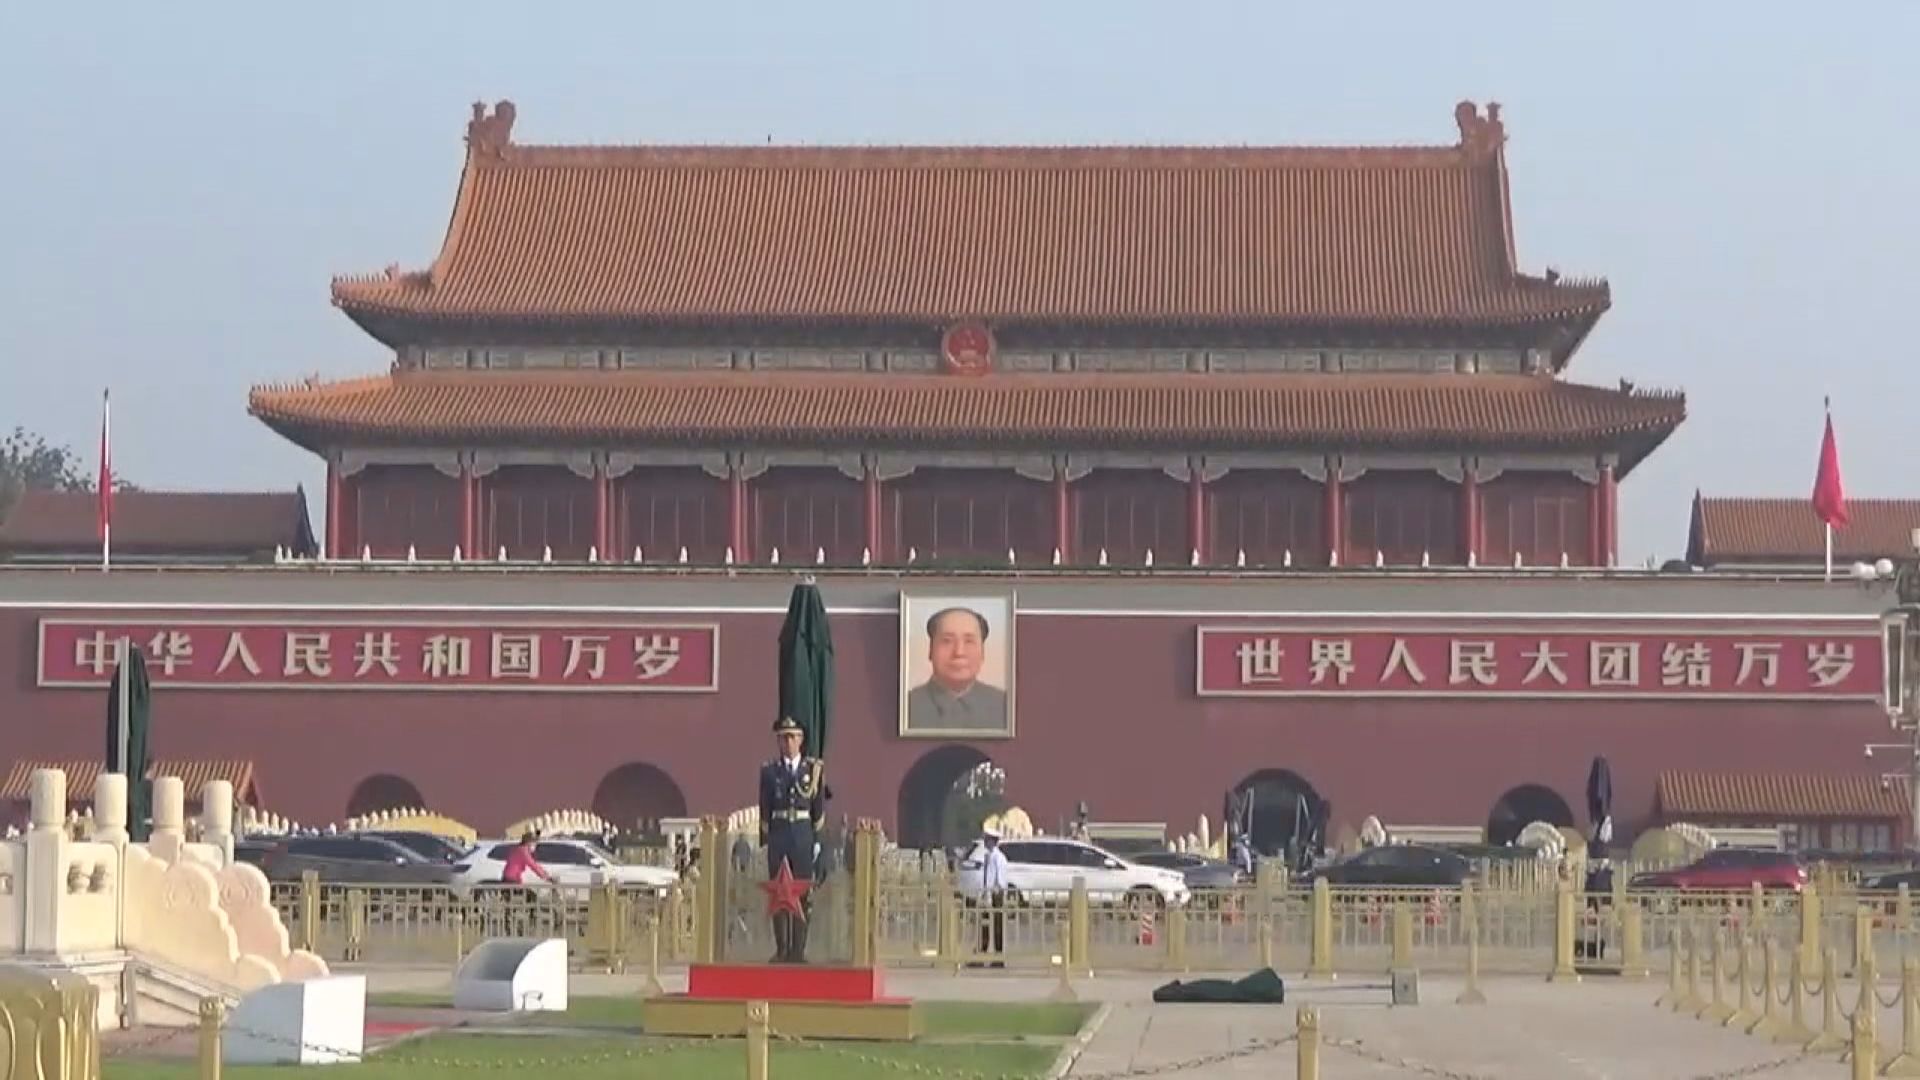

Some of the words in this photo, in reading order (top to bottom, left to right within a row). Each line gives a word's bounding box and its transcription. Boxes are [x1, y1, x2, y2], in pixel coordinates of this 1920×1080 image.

[76, 630, 681, 680] 中华人民共和国万岁
[1236, 637, 1856, 687] 世界人民大团结万岁
